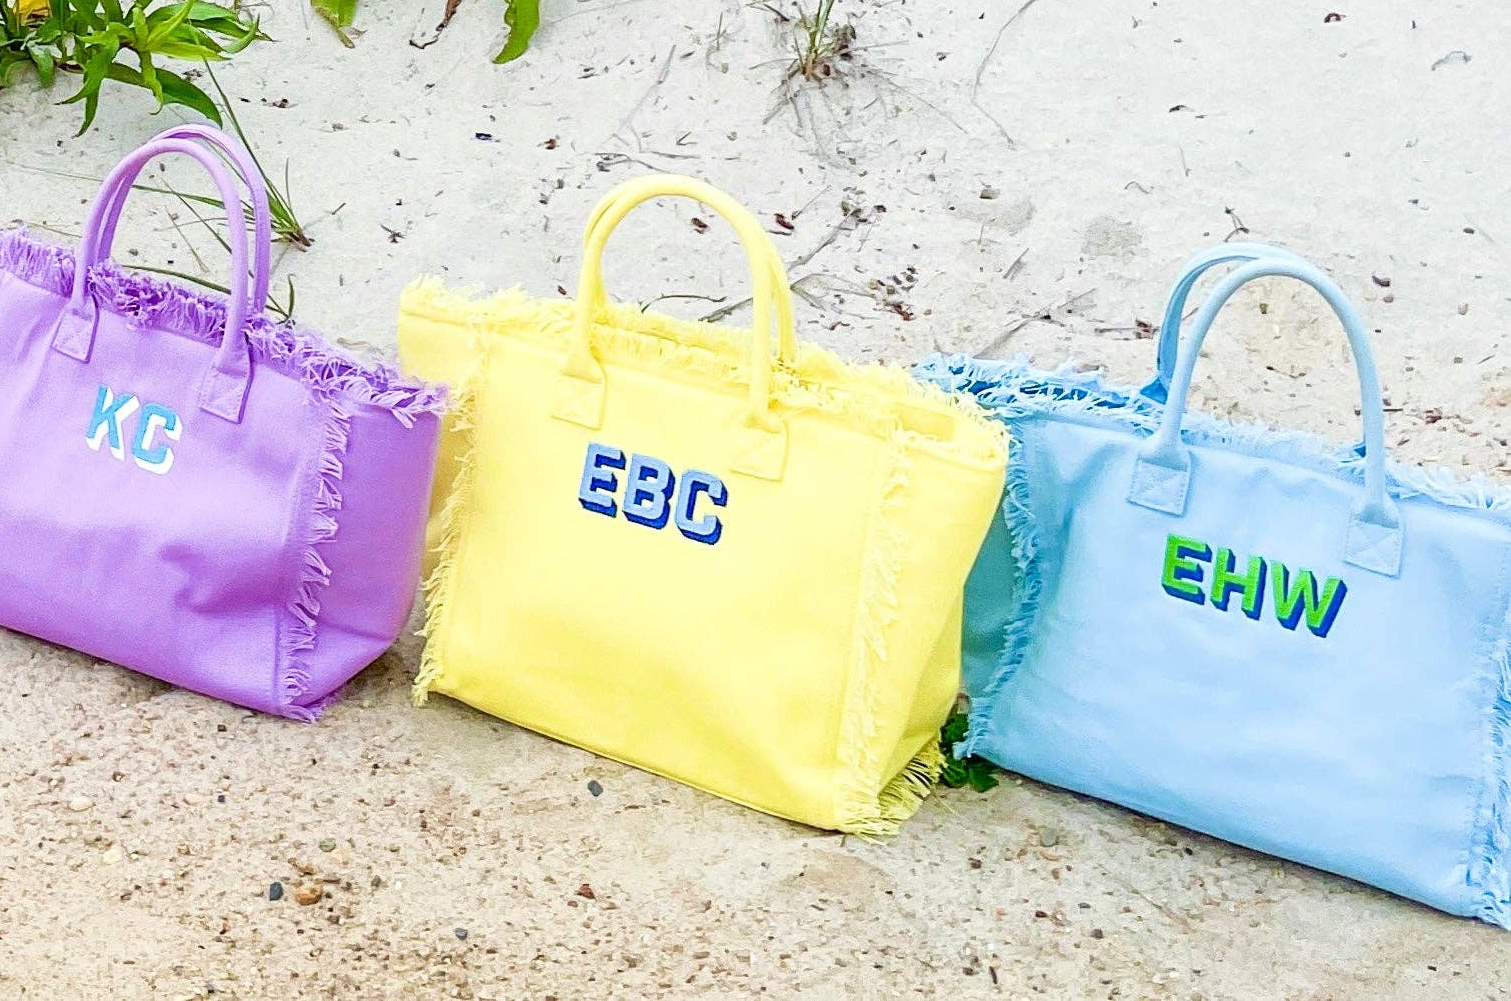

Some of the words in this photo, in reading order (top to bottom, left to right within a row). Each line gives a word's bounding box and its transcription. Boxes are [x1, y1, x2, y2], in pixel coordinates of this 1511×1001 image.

[85, 384, 183, 475] KC
[578, 442, 729, 545] EBC
[1161, 534, 1348, 638] EHW
